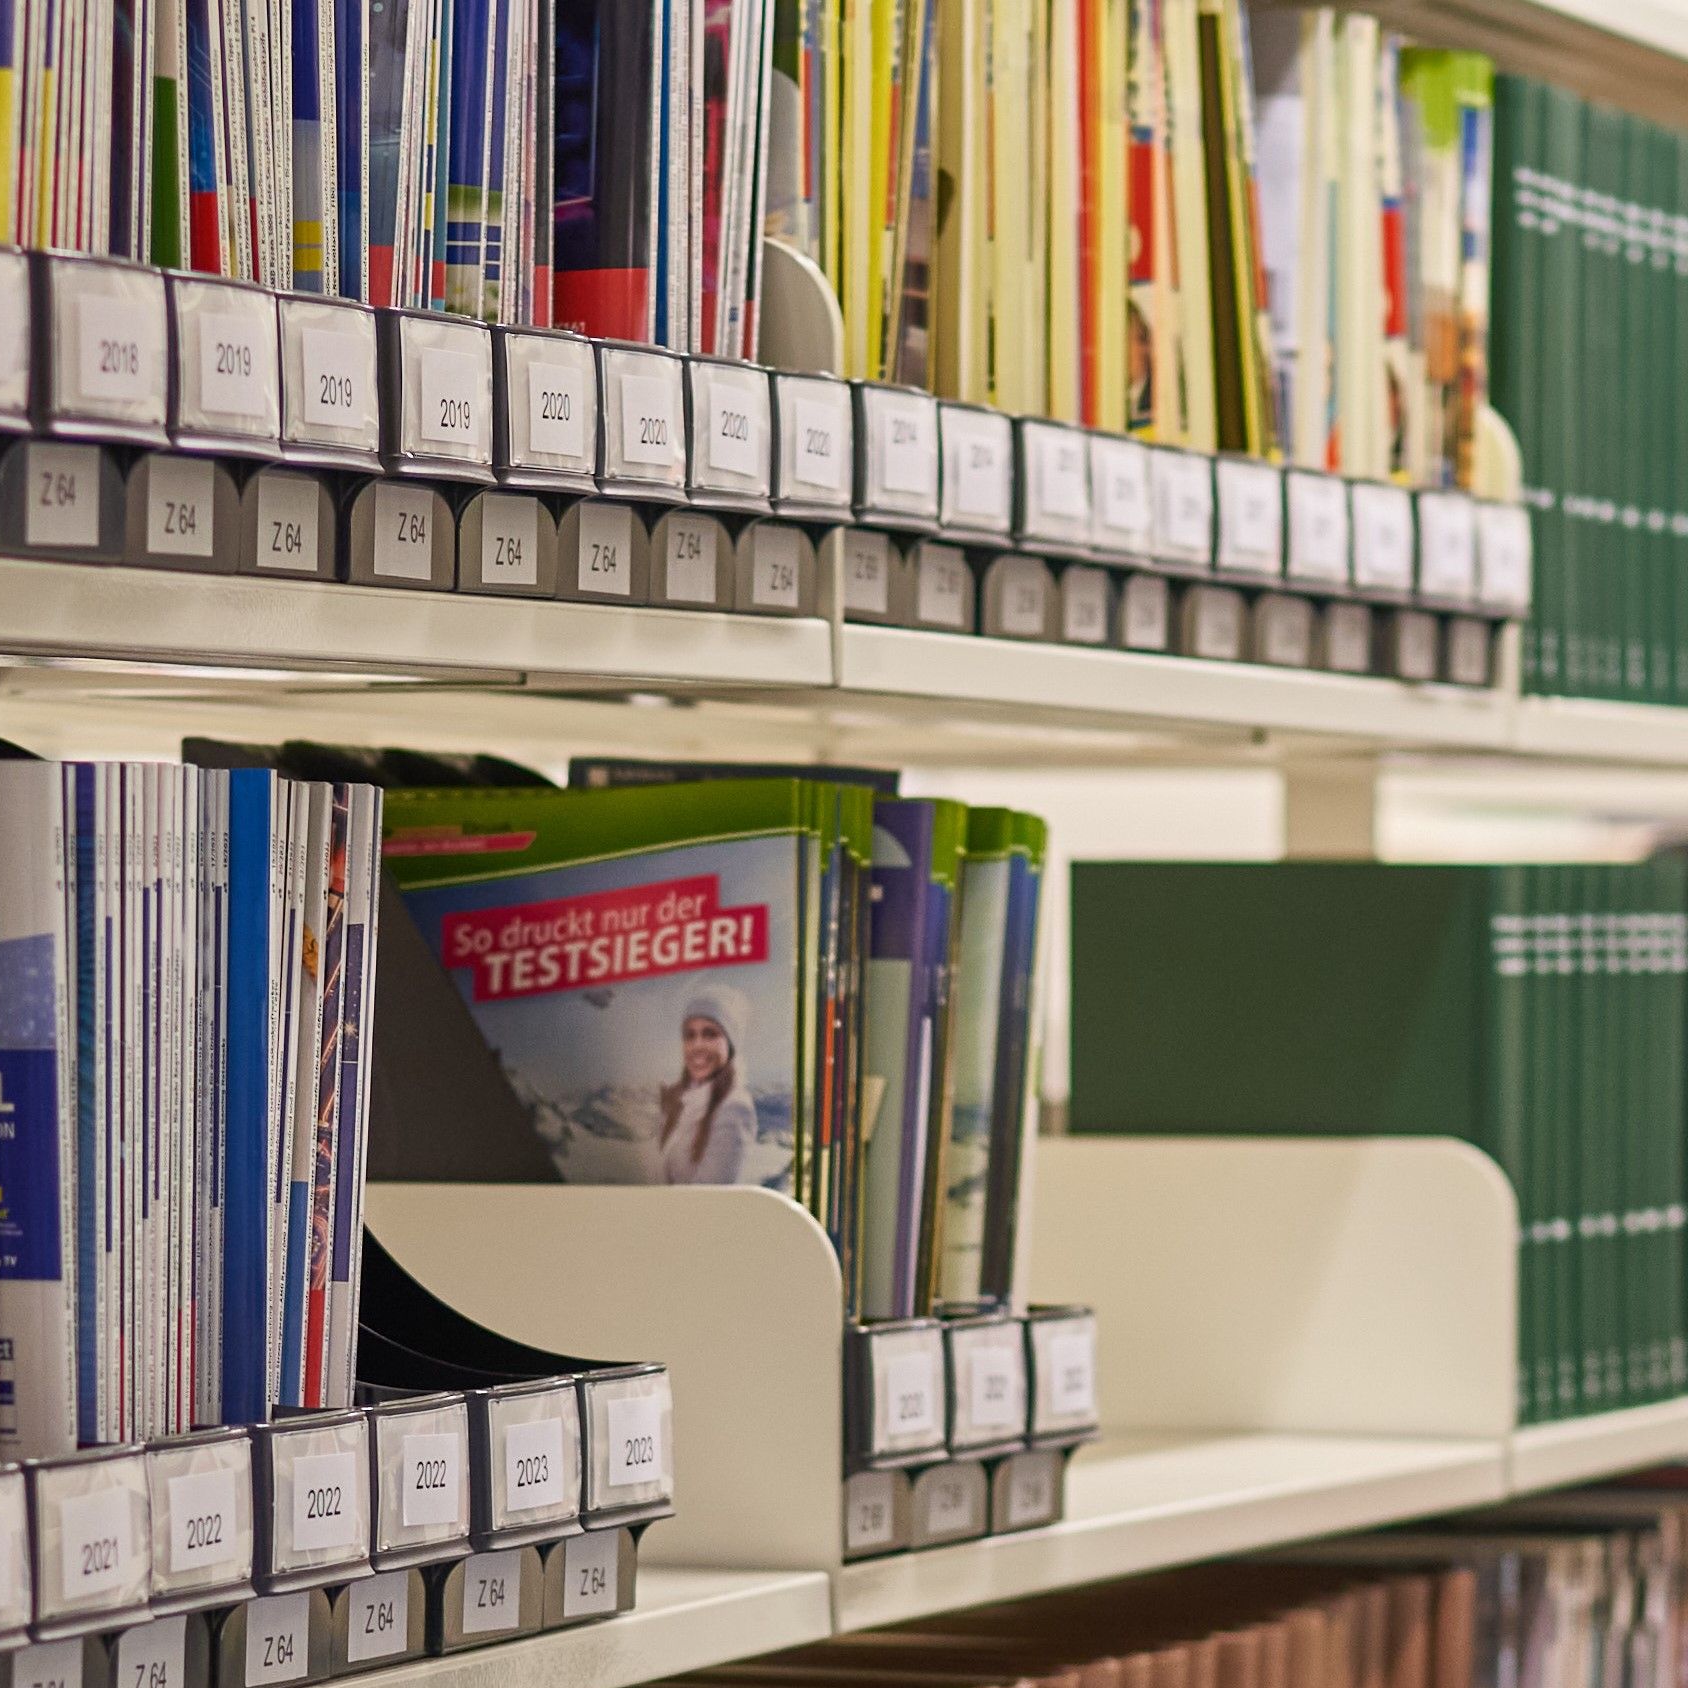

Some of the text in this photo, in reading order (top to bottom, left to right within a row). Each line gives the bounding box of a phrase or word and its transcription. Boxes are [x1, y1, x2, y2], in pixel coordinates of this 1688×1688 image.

[100, 340, 140, 375] 2018
[216, 344, 252, 377] 2019
[320, 374, 352, 408] 2019
[542, 390, 570, 421] 2020
[440, 398, 471, 430] 2019
[721, 410, 748, 442] 2020
[640, 416, 668, 446] 2020
[806, 427, 831, 457] 2020
[40, 473, 76, 506] Z 64
[165, 502, 197, 535] Z 64
[398, 511, 426, 545] Z 64
[272, 521, 302, 554] Z 64
[495, 537, 523, 567] Z 64
[677, 532, 701, 560] Z 64
[591, 543, 617, 574] Z 64
[771, 564, 780, 591] Z
[453, 890, 707, 956] So druckt nur der
[483, 913, 755, 994] TESTSIEGER!
[625, 1436, 654, 1467] 2023
[416, 1460, 446, 1490] 2022
[516, 1454, 549, 1487] 2023
[307, 1487, 342, 1519] 2022
[187, 1514, 223, 1550] 2022
[82, 1540, 121, 1576] 2021
[478, 1578, 505, 1608] Z 64
[581, 1566, 606, 1595] Z 64
[366, 1602, 394, 1633] Z 64
[264, 1634, 293, 1667] Z 64
